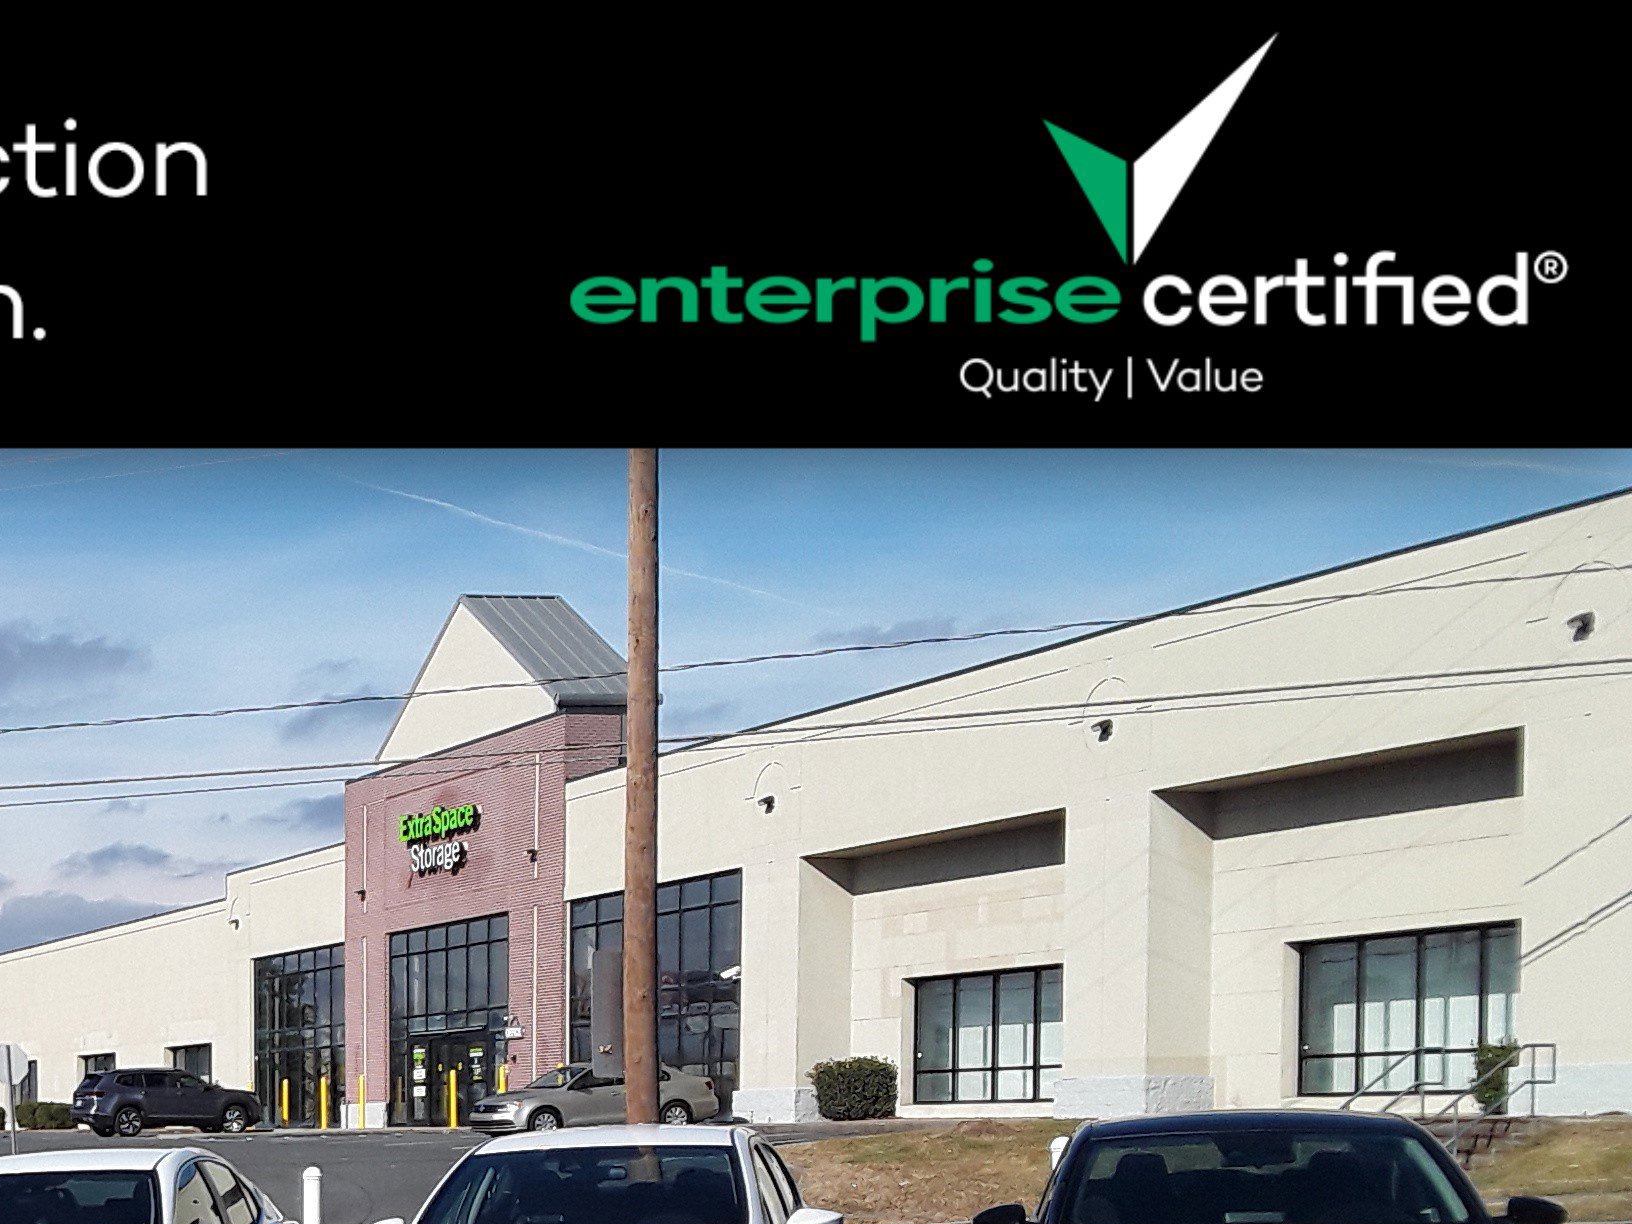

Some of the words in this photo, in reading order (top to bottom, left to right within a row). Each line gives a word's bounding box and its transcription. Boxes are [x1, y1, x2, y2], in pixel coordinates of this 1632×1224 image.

[399, 814, 432, 842] Extra
[432, 805, 474, 839] Space
[411, 844, 460, 872] Storage
